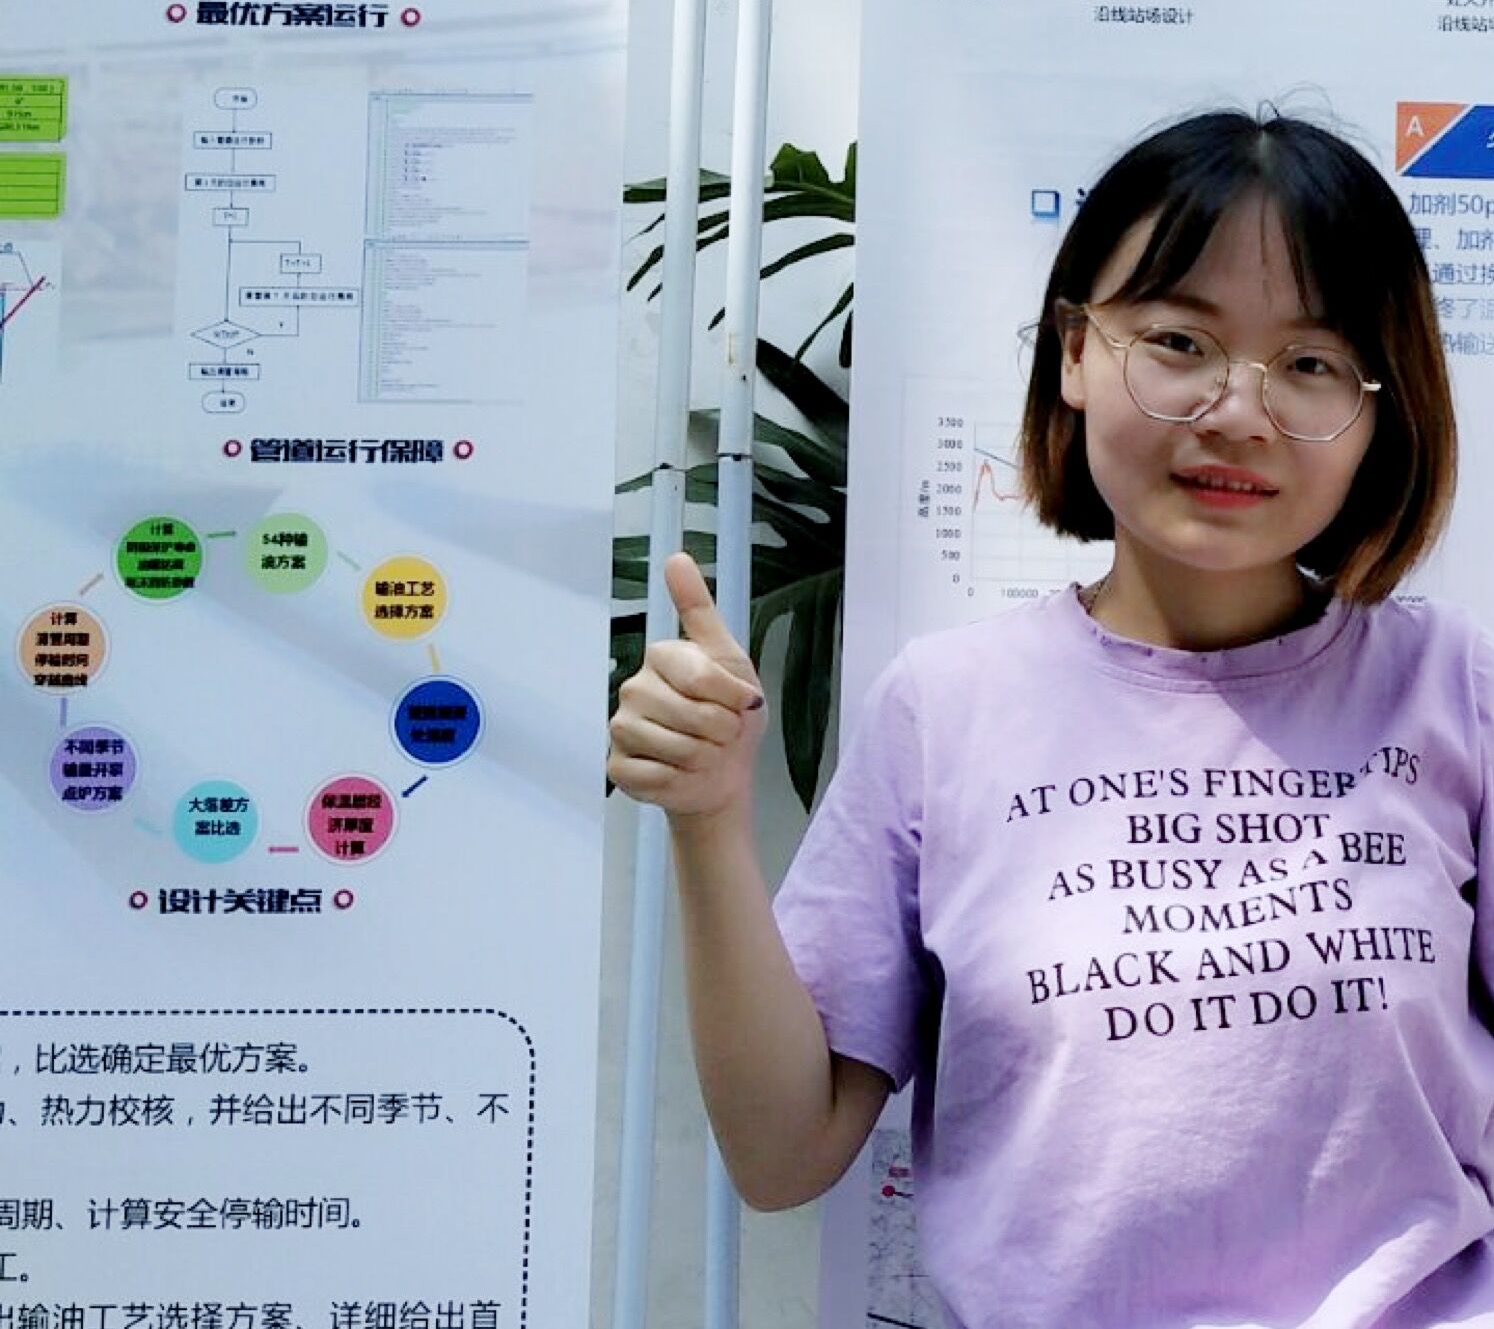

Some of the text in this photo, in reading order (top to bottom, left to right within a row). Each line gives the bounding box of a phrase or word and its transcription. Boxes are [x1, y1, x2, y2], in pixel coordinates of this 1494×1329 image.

[197, 1, 389, 28] 最优方案运行
[1405, 115, 1424, 137] A
[250, 437, 445, 464] 管道运行保障
[1006, 784, 1057, 823] AT
[1069, 767, 1190, 807] ONE'S
[1127, 812, 1331, 844] BIG SHOT
[1047, 831, 1407, 901] AS BUSY AS A BEE
[159, 888, 322, 915] 设计关键点
[1122, 877, 1353, 936] MOMENTS
[1027, 927, 1436, 1004] BLACK AND WHITE
[1104, 976, 1389, 1042] DO IT DO IT!
[0, 1092, 511, 1127] 、热力校核，并给出不同季节、不
